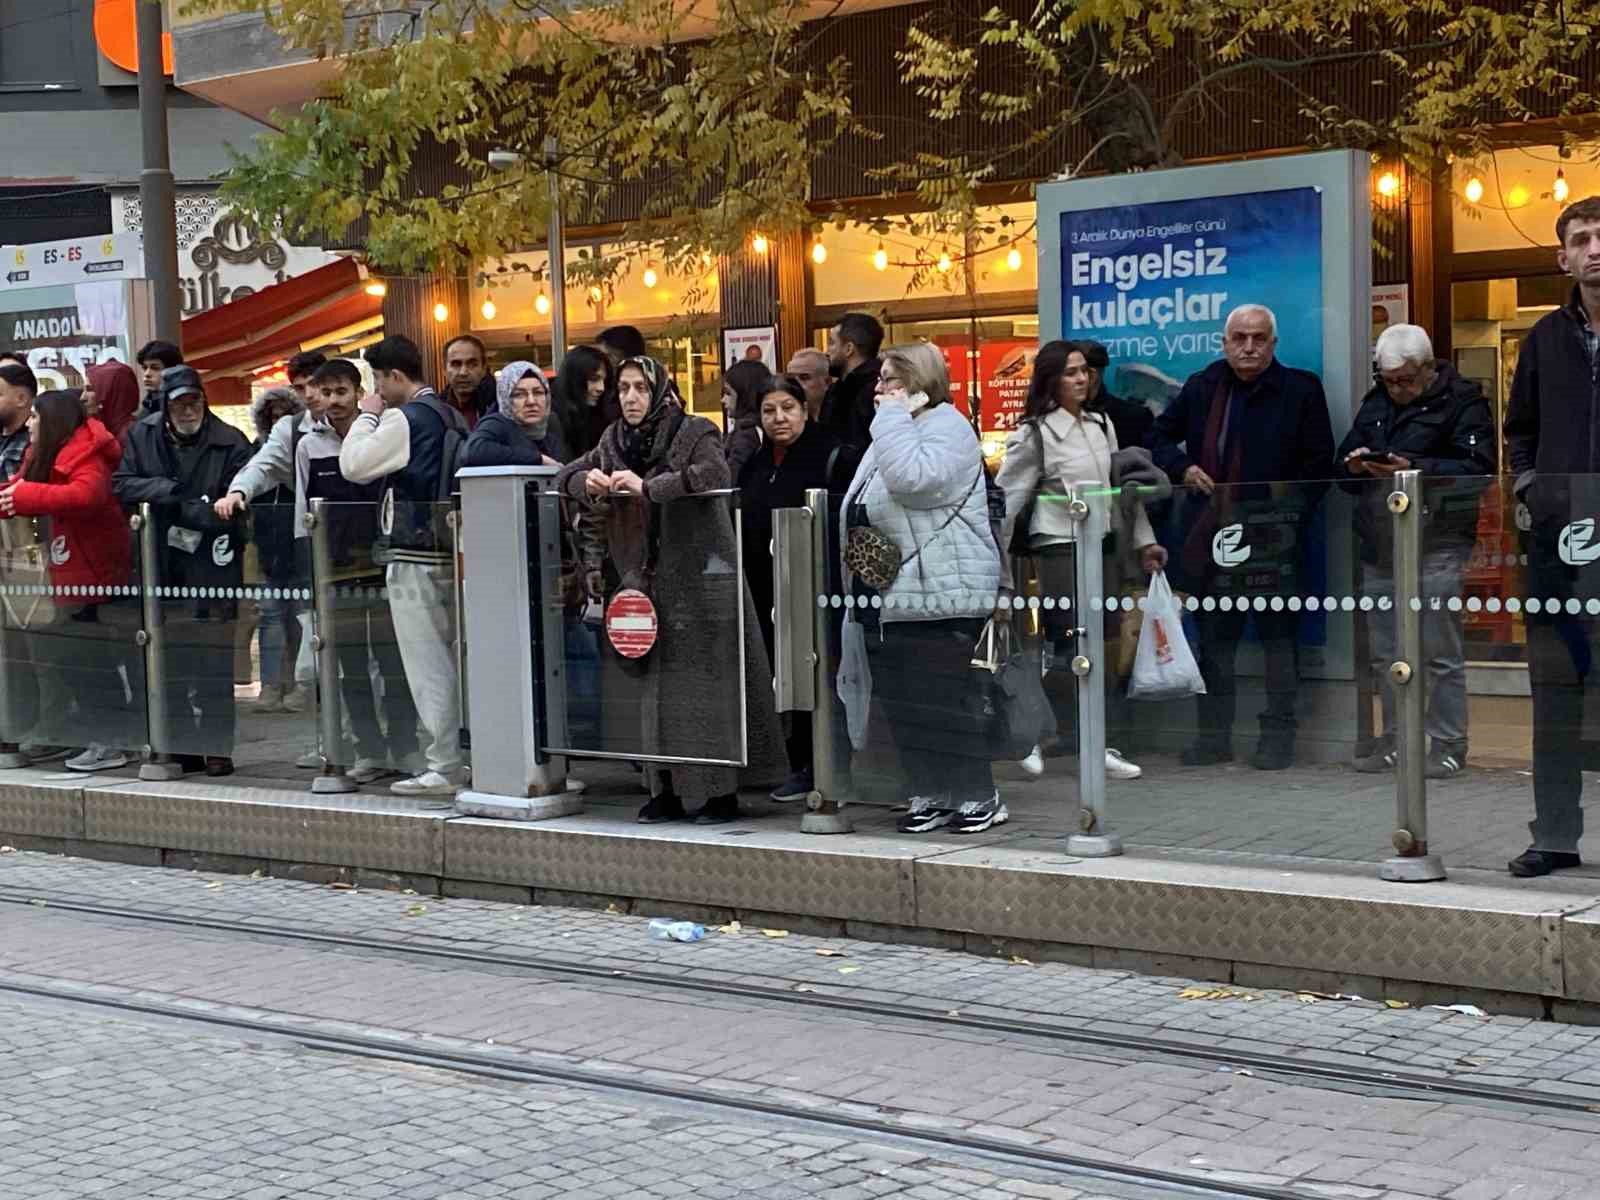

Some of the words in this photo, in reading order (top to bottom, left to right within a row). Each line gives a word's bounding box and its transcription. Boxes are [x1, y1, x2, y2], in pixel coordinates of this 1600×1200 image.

[1079, 230, 1108, 243] Aralık
[1110, 228, 1145, 241] Dünya
[1147, 222, 1193, 238] Engelliler
[1195, 219, 1226, 232] Günü
[44, 249, 58, 264] ES
[68, 246, 82, 261] ES
[1071, 238, 1227, 291] Engelsiz
[1071, 287, 1228, 330] kulaçlar
[13, 315, 89, 340] ANADOL
[1090, 335, 1158, 358] zme
